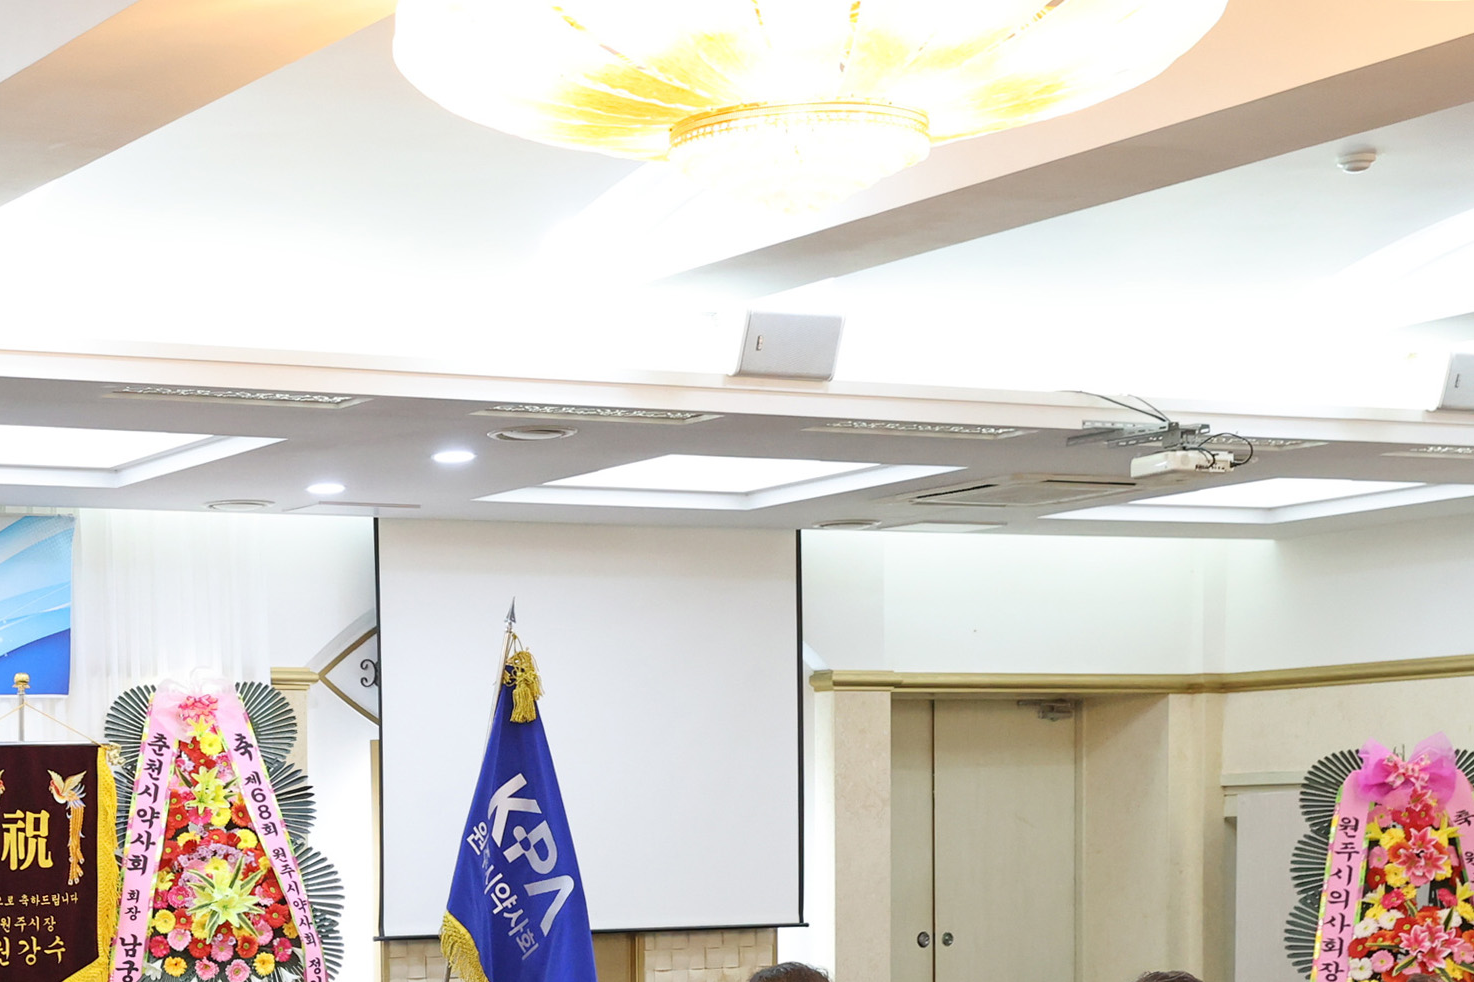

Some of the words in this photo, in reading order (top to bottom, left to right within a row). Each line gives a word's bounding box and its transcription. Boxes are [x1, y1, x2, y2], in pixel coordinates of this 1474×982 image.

[126, 733, 171, 876] 춘천시약사회
[0, 809, 54, 871] 祝
[233, 733, 254, 762] 축
[244, 771, 279, 837] 제68회
[271, 847, 317, 947] 원주시약사회
[0, 915, 57, 933] 원주시장
[18, 892, 79, 907] 축하드립니다
[124, 889, 142, 921] 회장
[1319, 816, 1360, 982] 원주시의사회장
